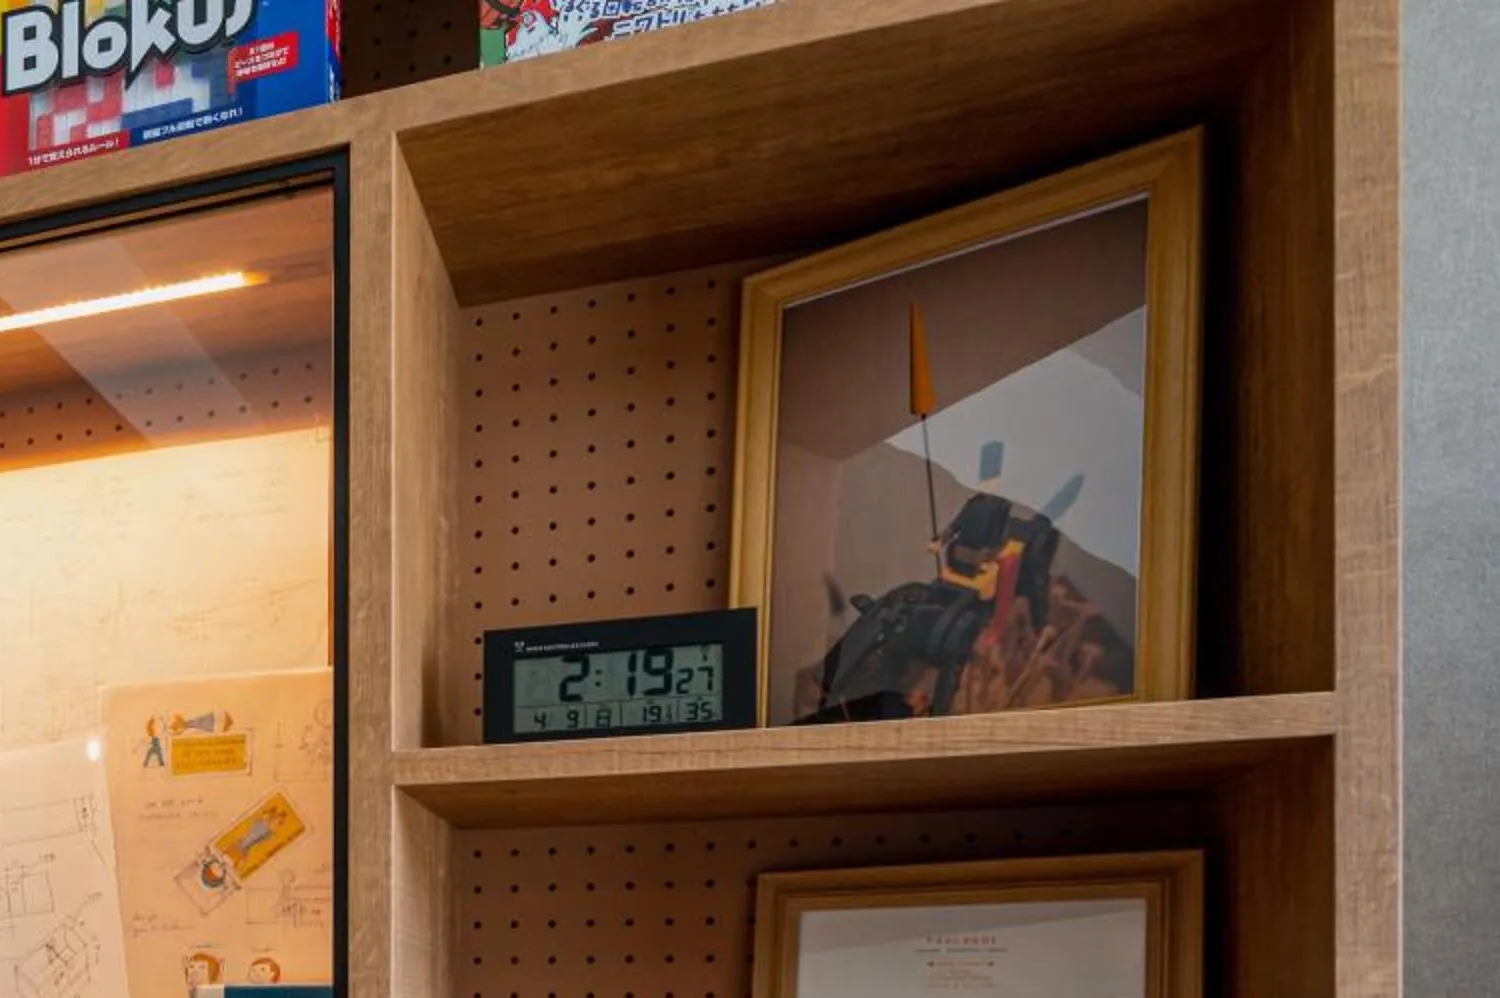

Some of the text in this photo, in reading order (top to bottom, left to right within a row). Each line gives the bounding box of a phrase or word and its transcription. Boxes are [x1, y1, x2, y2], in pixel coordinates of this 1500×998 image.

[559, 648, 714, 701] 2:19 27
[566, 709, 580, 729] 9
[687, 702, 714, 721] 35
